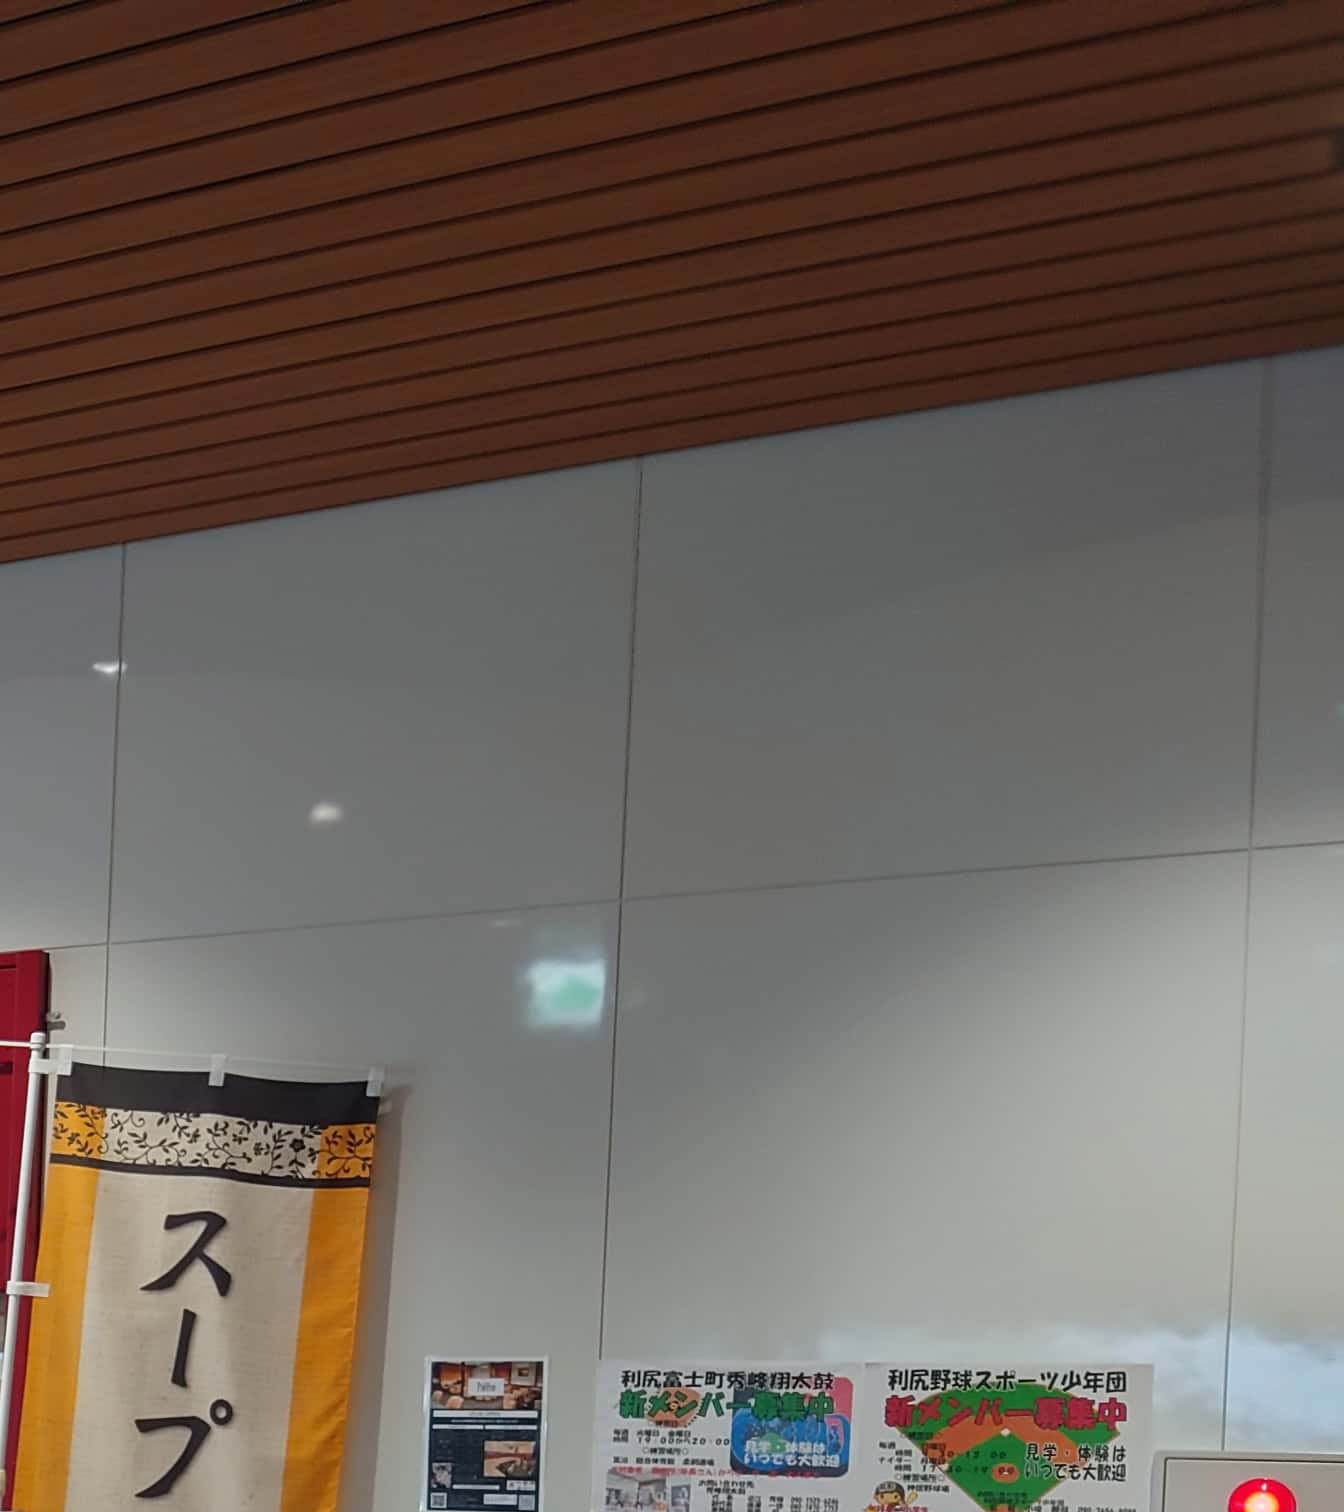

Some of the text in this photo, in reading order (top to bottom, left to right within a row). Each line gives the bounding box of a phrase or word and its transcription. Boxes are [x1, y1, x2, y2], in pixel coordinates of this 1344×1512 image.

[888, 1369, 1127, 1393] 利尻野球スポーツ少年団
[618, 1389, 835, 1423] 新メンバー募集中
[884, 1395, 1128, 1430] 新メンバー募集中
[1025, 1444, 1127, 1462] 見学・体験は
[1024, 1463, 1127, 1483] いつでも大歓迎
